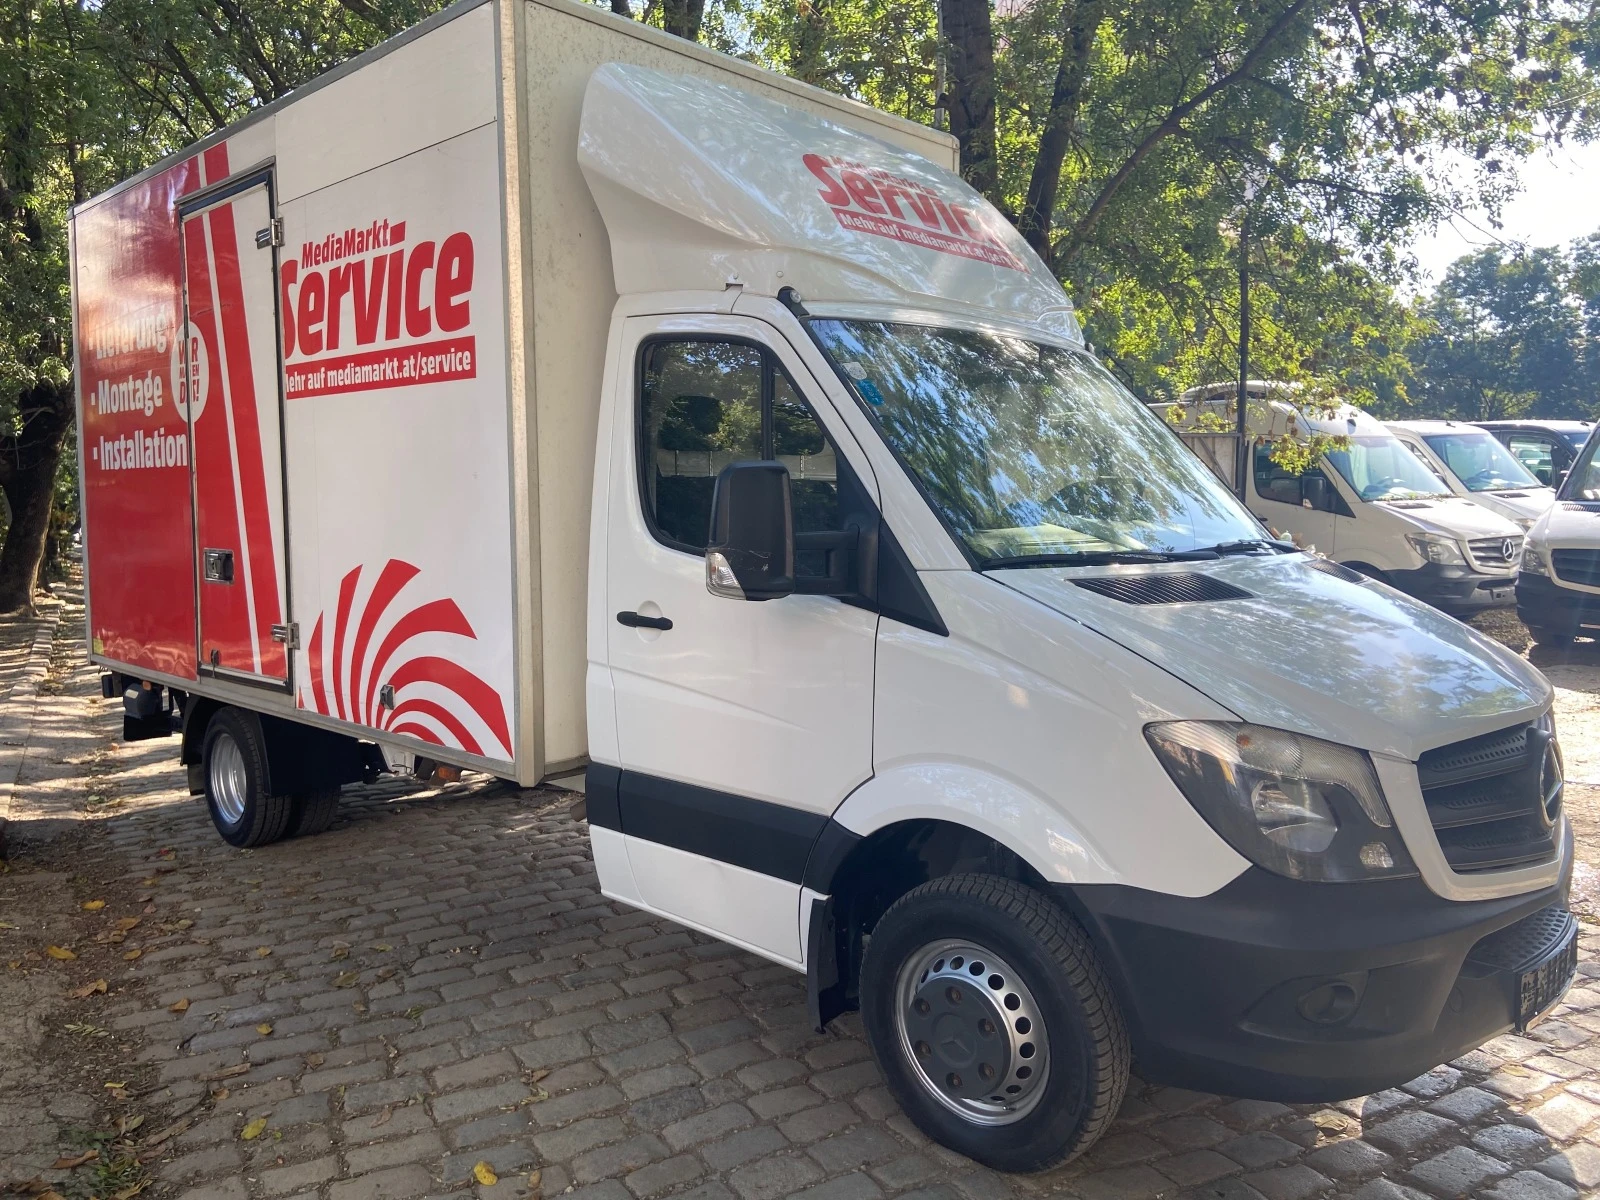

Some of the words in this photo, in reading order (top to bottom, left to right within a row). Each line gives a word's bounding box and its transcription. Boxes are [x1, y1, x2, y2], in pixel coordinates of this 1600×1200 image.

[302, 218, 390, 269] MediaMarkt
[839, 213, 876, 231] Mehr
[877, 222, 901, 238] auf
[307, 367, 326, 390] auf
[326, 347, 471, 387] mediamarkt.at/service
[98, 369, 163, 417] Montage
[100, 427, 188, 471] Installation
